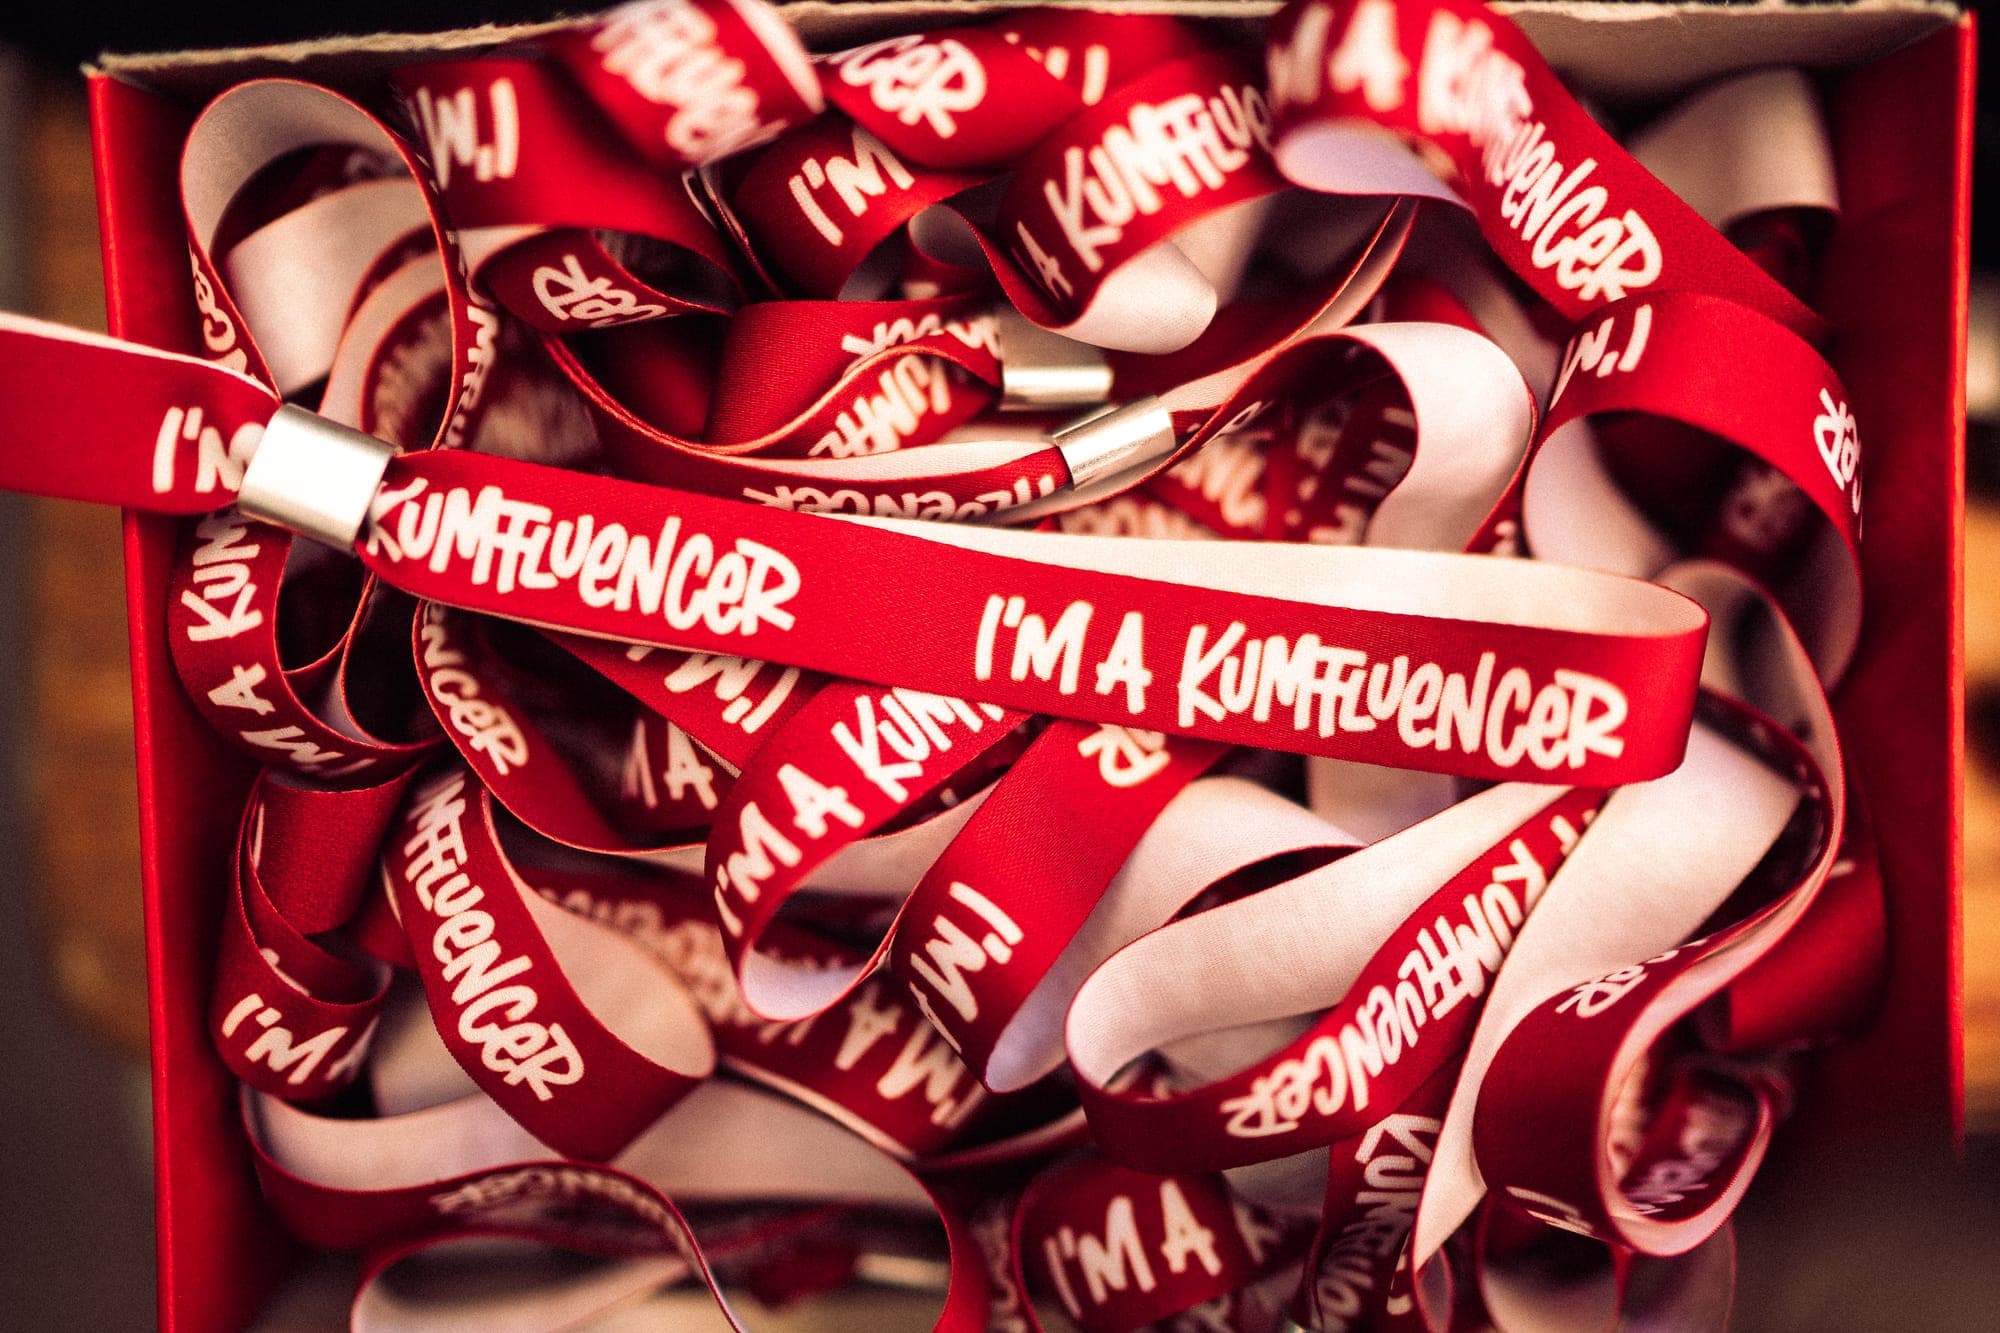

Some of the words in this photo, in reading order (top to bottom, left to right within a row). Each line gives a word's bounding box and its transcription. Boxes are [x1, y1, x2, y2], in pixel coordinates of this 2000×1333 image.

[788, 127, 915, 246] I'M
[207, 661, 275, 716] A
[973, 594, 1094, 695] I'M
[1095, 611, 1152, 715] A
[714, 801, 803, 937] I'M
[777, 763, 865, 838] A
[910, 881, 1023, 1022] I'M
[221, 992, 348, 1085] I'M
[1043, 1195, 1156, 1320] I'M
[1159, 1180, 1223, 1276] A
